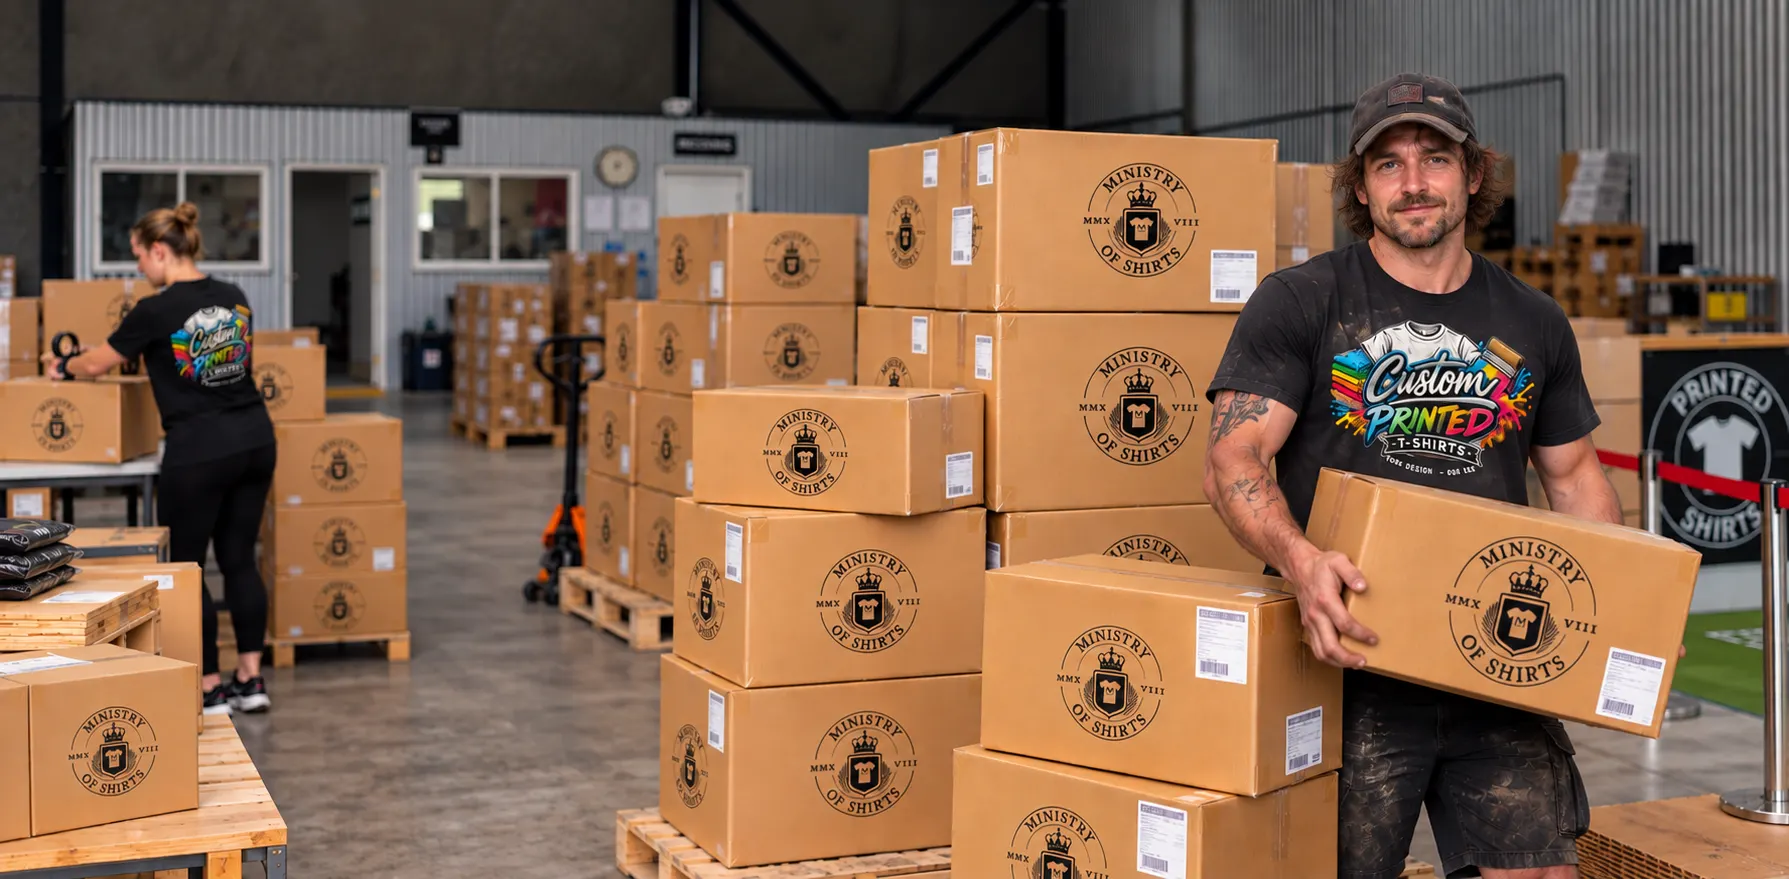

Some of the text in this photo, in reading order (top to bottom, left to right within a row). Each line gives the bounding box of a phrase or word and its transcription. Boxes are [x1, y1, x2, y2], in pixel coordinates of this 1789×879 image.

[1102, 166, 1184, 193] MINISTRY
[1101, 245, 1180, 274] OF SHIRTS
[1099, 350, 1182, 378] MINISTRY
[1365, 352, 1499, 403] Custom
[1671, 369, 1773, 417] PRINTED
[777, 411, 836, 432] MINISTRY
[1365, 404, 1494, 444] PRINTED
[1097, 432, 1179, 462] OF SHIRTS
[776, 471, 835, 493] OF SHIRTS
[1680, 502, 1761, 542] SHIRTS
[833, 553, 906, 579] MINISTRY
[1480, 541, 1585, 584] MINISTRY
[816, 600, 840, 608] MMX
[1445, 593, 1481, 609] MMX
[832, 625, 904, 650] OF SHIRTS
[1564, 618, 1598, 634] VIII
[1075, 629, 1151, 658] MINISTRY
[1461, 634, 1565, 682] OF SHIRTS
[1057, 674, 1080, 683] MMX
[1141, 685, 1164, 695] VIII
[83, 709, 146, 733] MINISTRY
[829, 714, 902, 741] MINISTRY
[1072, 704, 1146, 737] OF SHIRTS
[82, 769, 144, 793] OF SHIRTS
[810, 764, 835, 772] MMX
[827, 787, 900, 814] OF SHIRTS
[1024, 810, 1095, 842] MINISTRY
[1007, 852, 1029, 863] MMX
